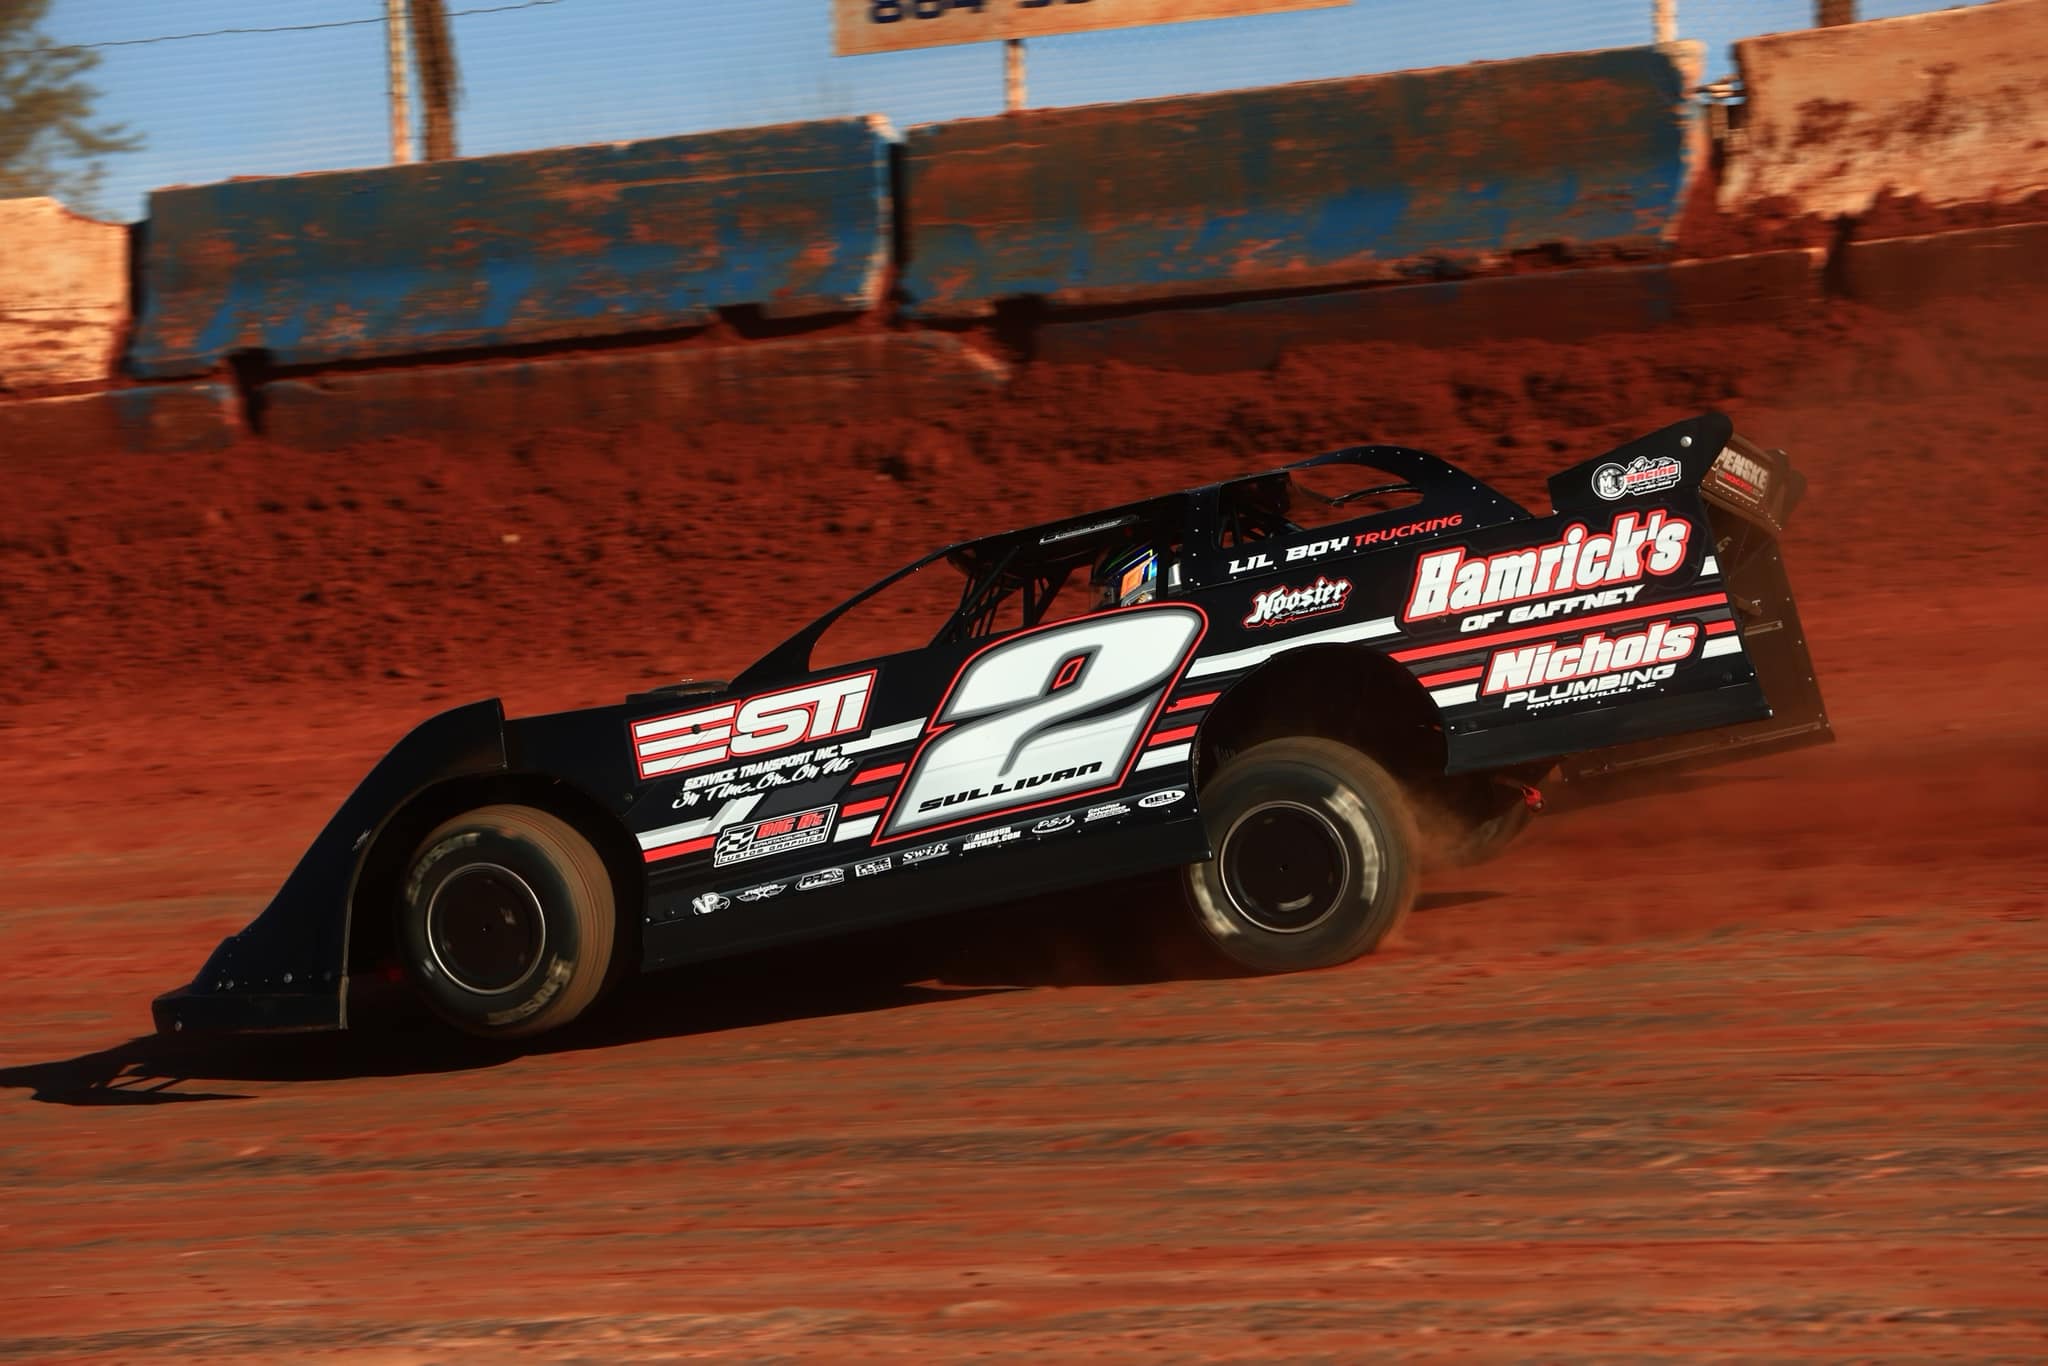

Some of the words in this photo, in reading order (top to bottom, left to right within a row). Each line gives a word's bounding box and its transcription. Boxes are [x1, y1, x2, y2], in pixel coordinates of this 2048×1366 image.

[1714, 446, 1768, 490] PENSKE
[1228, 554, 1274, 574] LIL
[1286, 536, 1350, 562] BOY
[1354, 514, 1463, 547] TRUCKING
[1405, 511, 1691, 622] Hamrick's
[1246, 578, 1349, 624] Hoosier
[1460, 610, 1503, 632] OF
[1508, 584, 1646, 624] GAFFNEY
[1484, 620, 1698, 695] Nichols
[1503, 663, 1677, 709] PLUMBING
[1636, 681, 1657, 690] NC
[884, 608, 1201, 838] 2
[682, 768, 738, 791] SERVICE
[739, 750, 815, 778] TRANSPORT
[918, 761, 1103, 813] SULLIVAN
[1144, 792, 1180, 805] BELL
[720, 848, 764, 863] CUSTOM
[769, 835, 823, 851] GRAPHICS
[962, 831, 1022, 851] METALS.COM
[974, 826, 1012, 841] ARMOUR
[692, 892, 720, 914] VP
